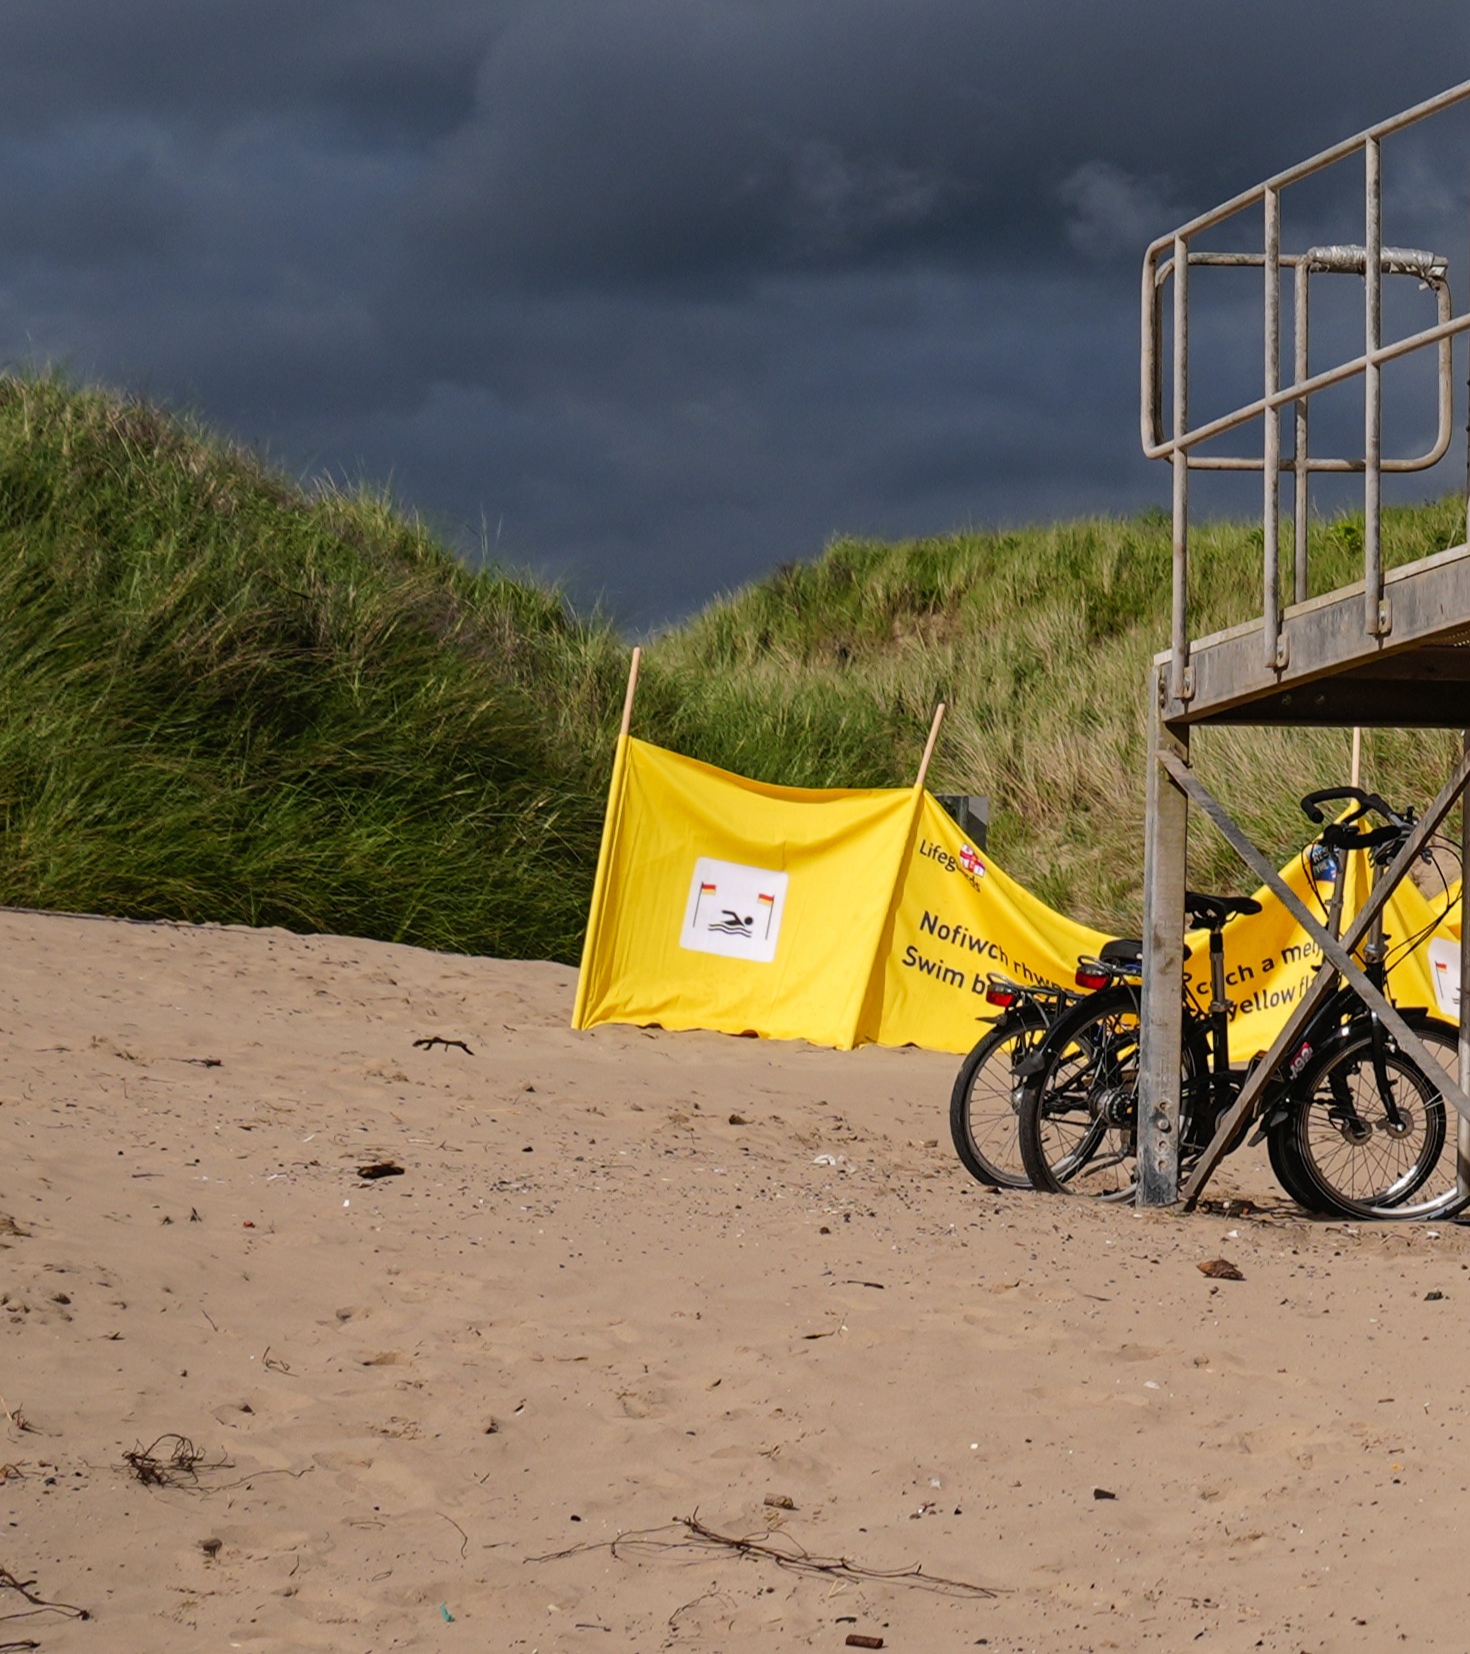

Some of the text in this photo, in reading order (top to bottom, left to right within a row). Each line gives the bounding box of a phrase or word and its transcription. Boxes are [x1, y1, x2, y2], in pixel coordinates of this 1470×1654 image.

[902, 945, 966, 988] Swim
[1227, 985, 1296, 1023] yellow
[919, 910, 1009, 967] Nofiwch
[1196, 964, 1255, 995] cch
[1261, 957, 1275, 974] a
